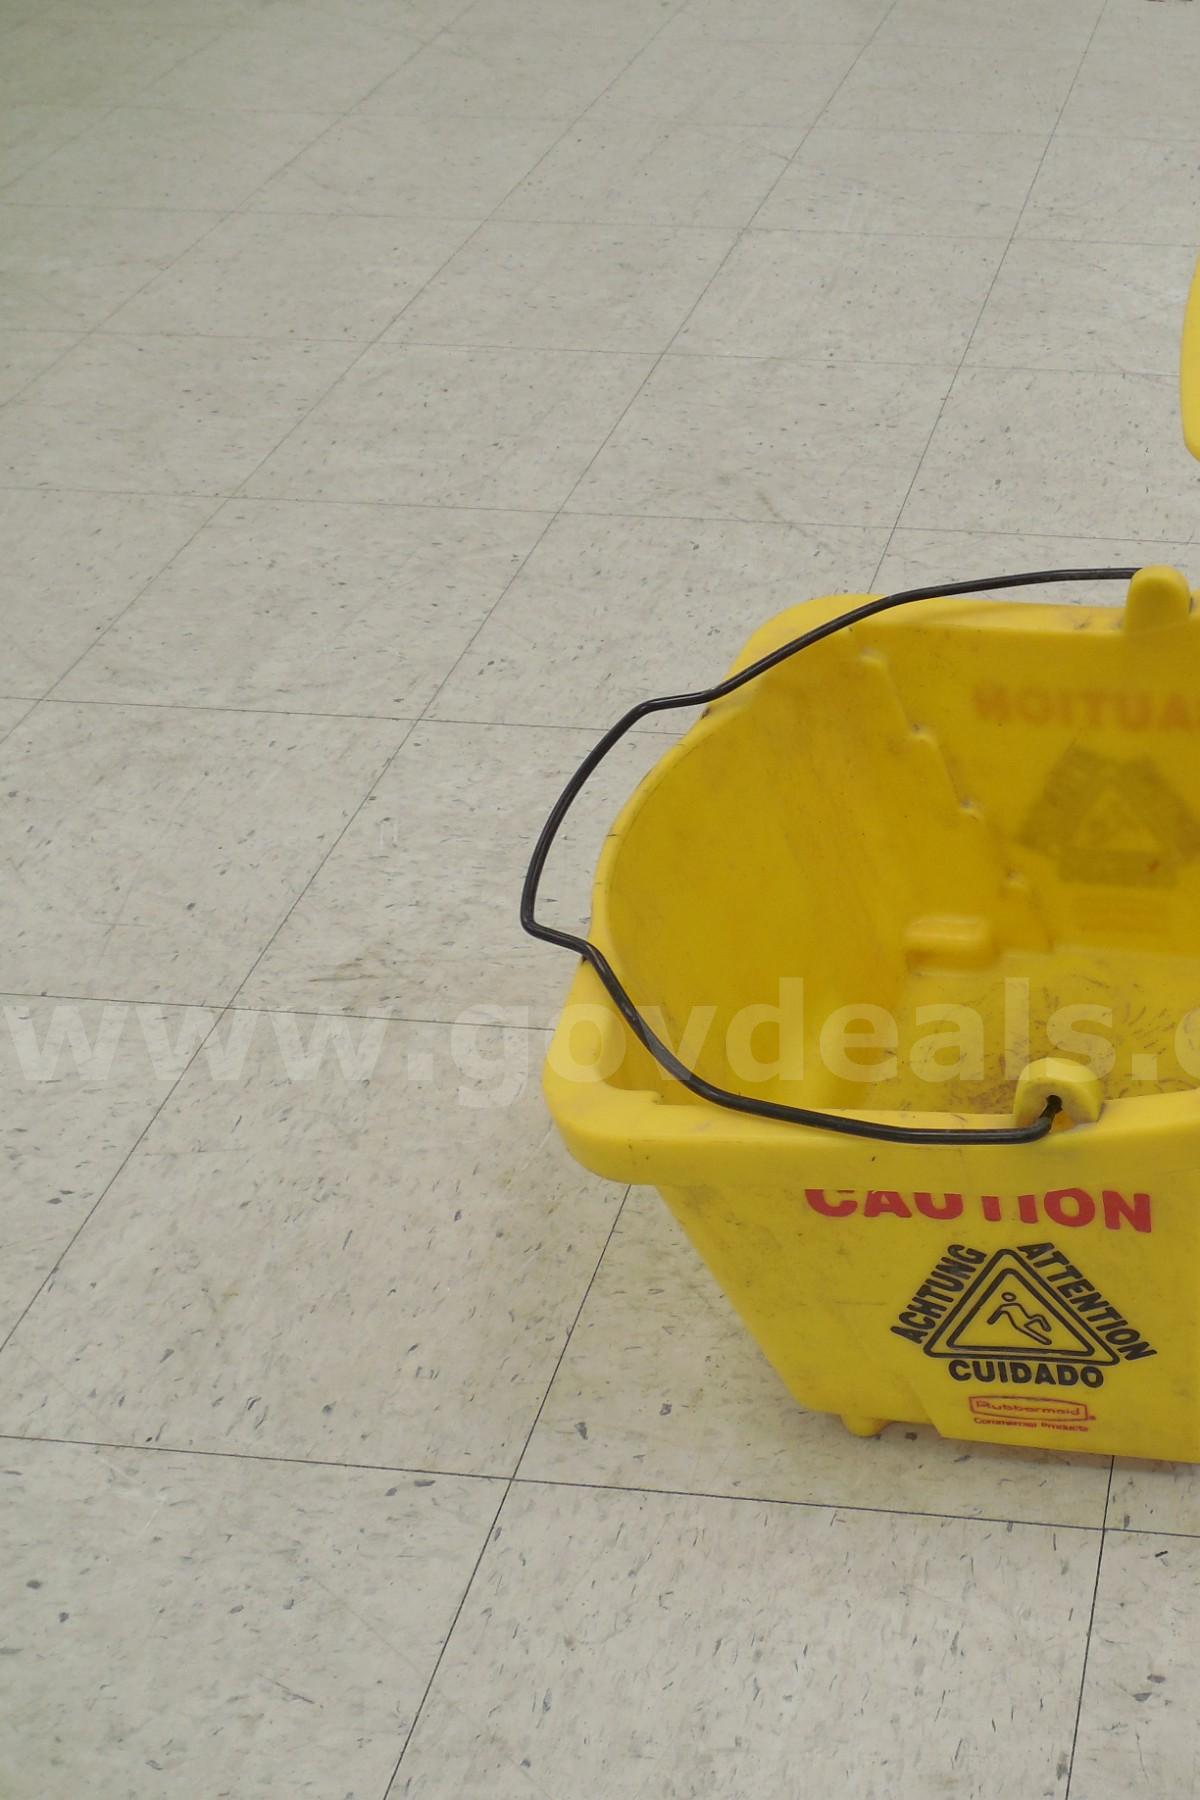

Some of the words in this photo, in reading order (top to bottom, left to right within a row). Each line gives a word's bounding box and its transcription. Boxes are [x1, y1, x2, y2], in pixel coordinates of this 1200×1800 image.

[890, 1244, 987, 1345] ACHTUNG
[1016, 1242, 1157, 1361] ATTENTION
[948, 1360, 1104, 1388] CUIDADO
[975, 1400, 1081, 1415] Rubbermaid
